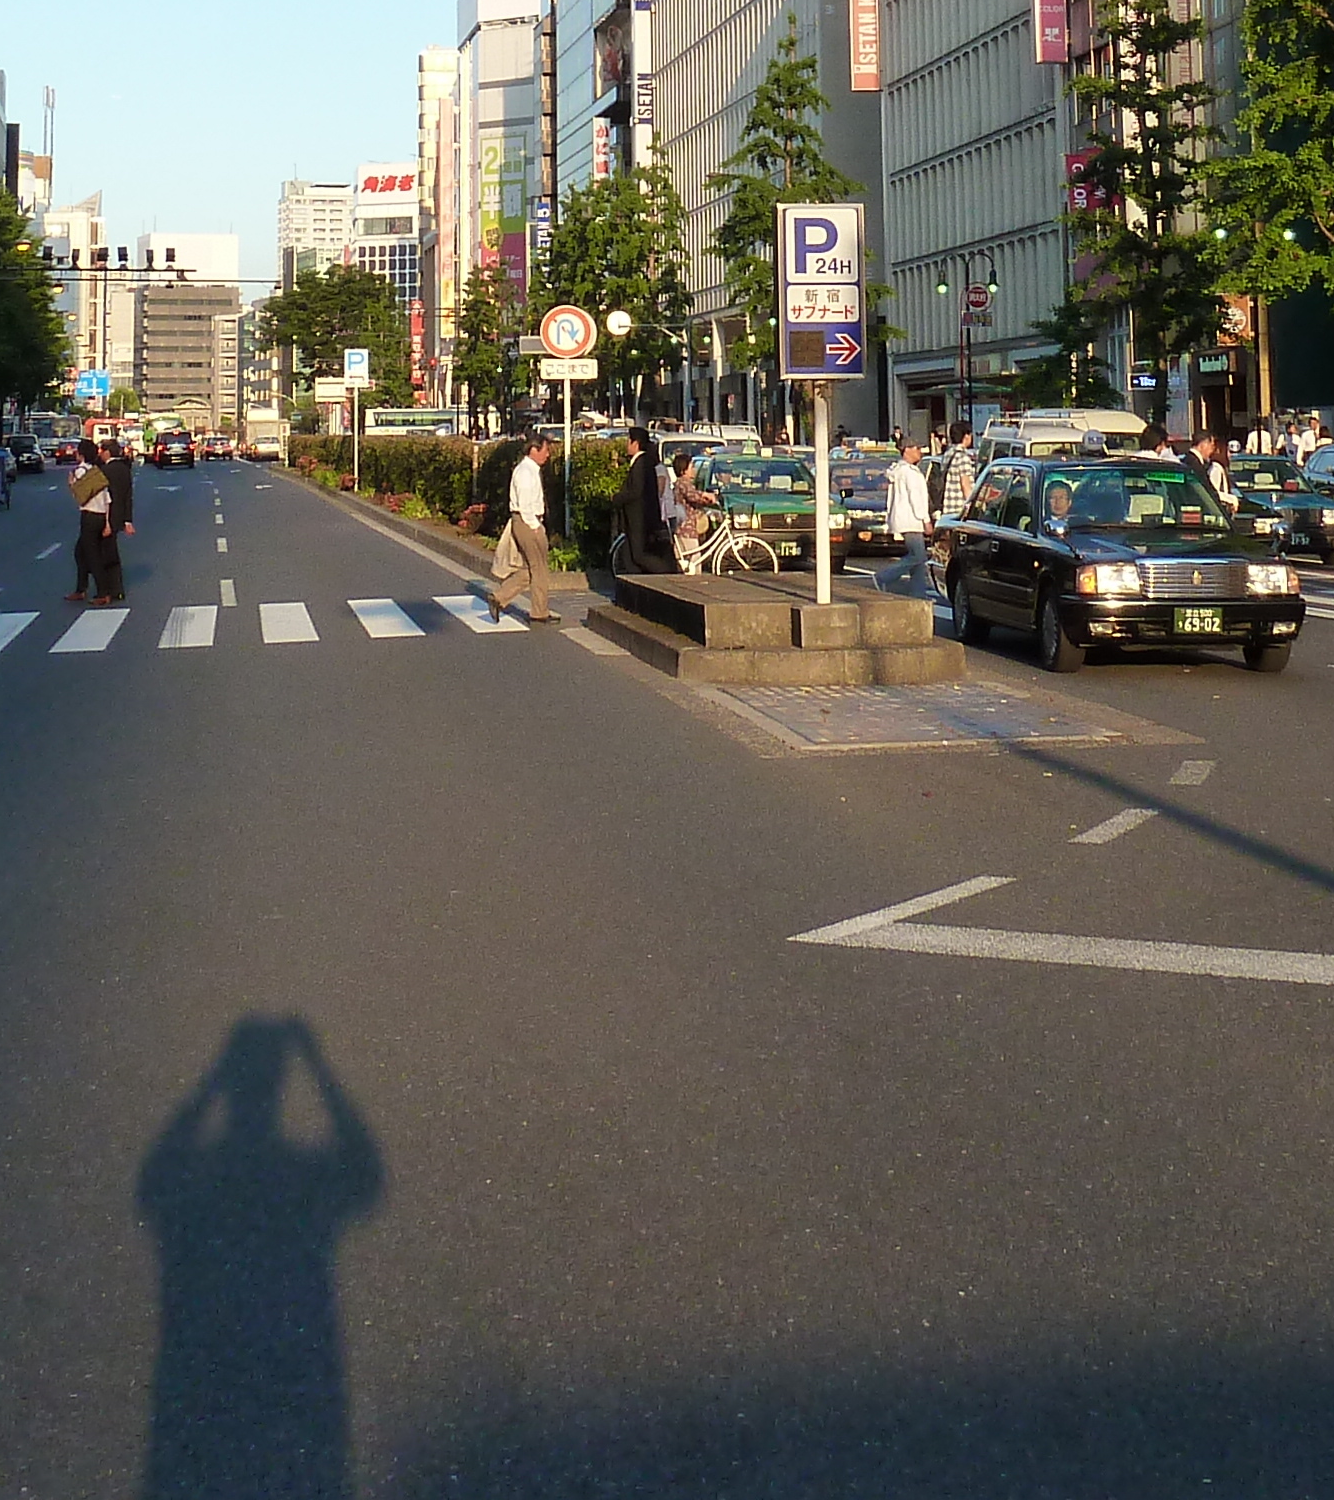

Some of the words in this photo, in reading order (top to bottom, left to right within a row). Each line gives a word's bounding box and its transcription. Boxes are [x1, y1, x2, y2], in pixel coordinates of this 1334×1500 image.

[1071, 163, 1087, 209] CLOR
[793, 217, 839, 274] P
[815, 257, 852, 275] 24H
[804, 288, 841, 304] 新宿
[348, 353, 364, 370] P
[545, 363, 590, 376] ここまで
